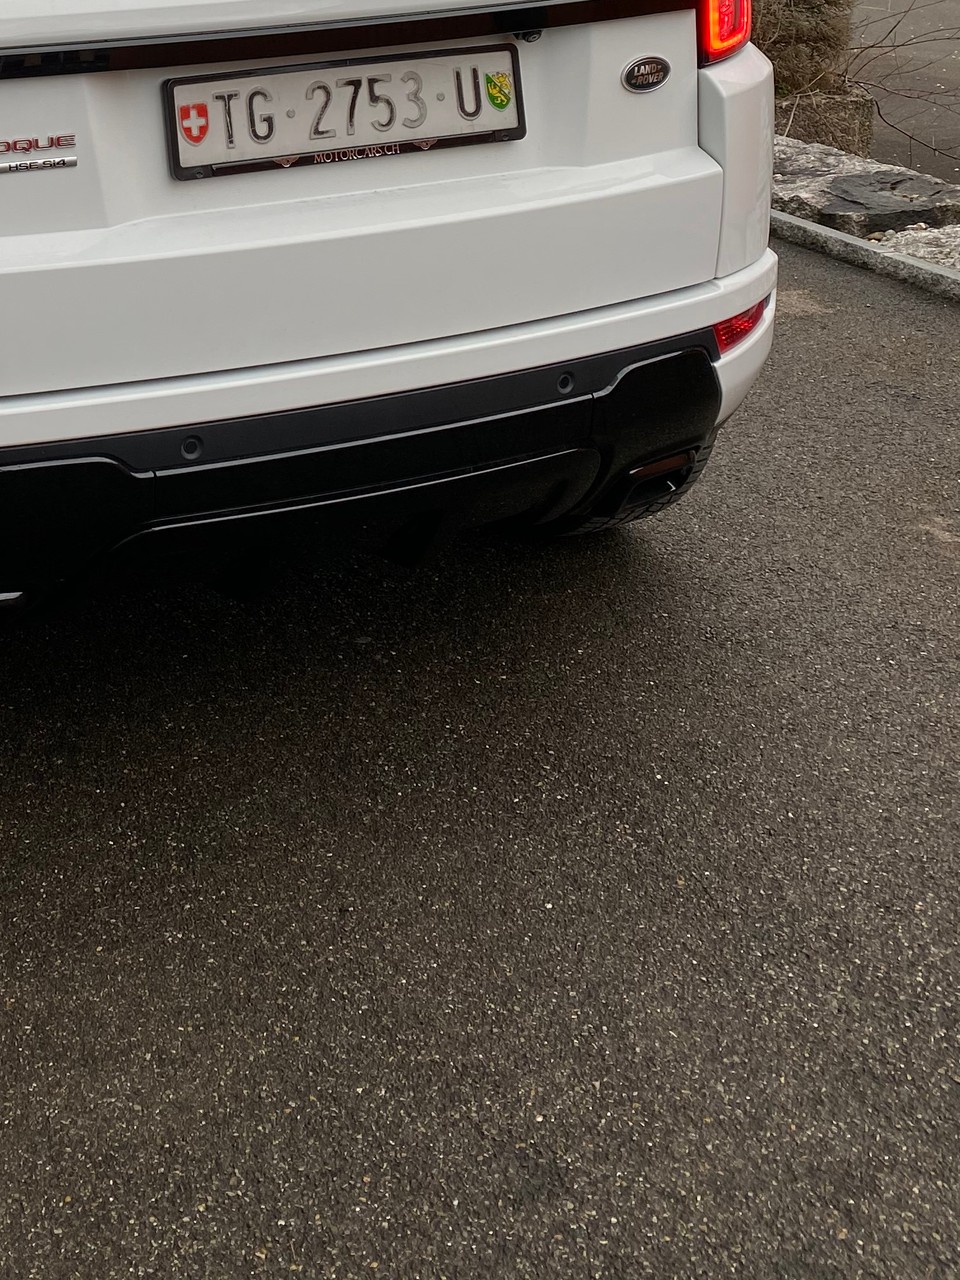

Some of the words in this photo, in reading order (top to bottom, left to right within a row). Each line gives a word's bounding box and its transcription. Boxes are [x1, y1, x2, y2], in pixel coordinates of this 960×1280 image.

[634, 63, 657, 76] LAND
[636, 72, 664, 86] ROVER
[313, 143, 400, 164] MOTORCARS.CH
[8, 161, 39, 172] HSE
